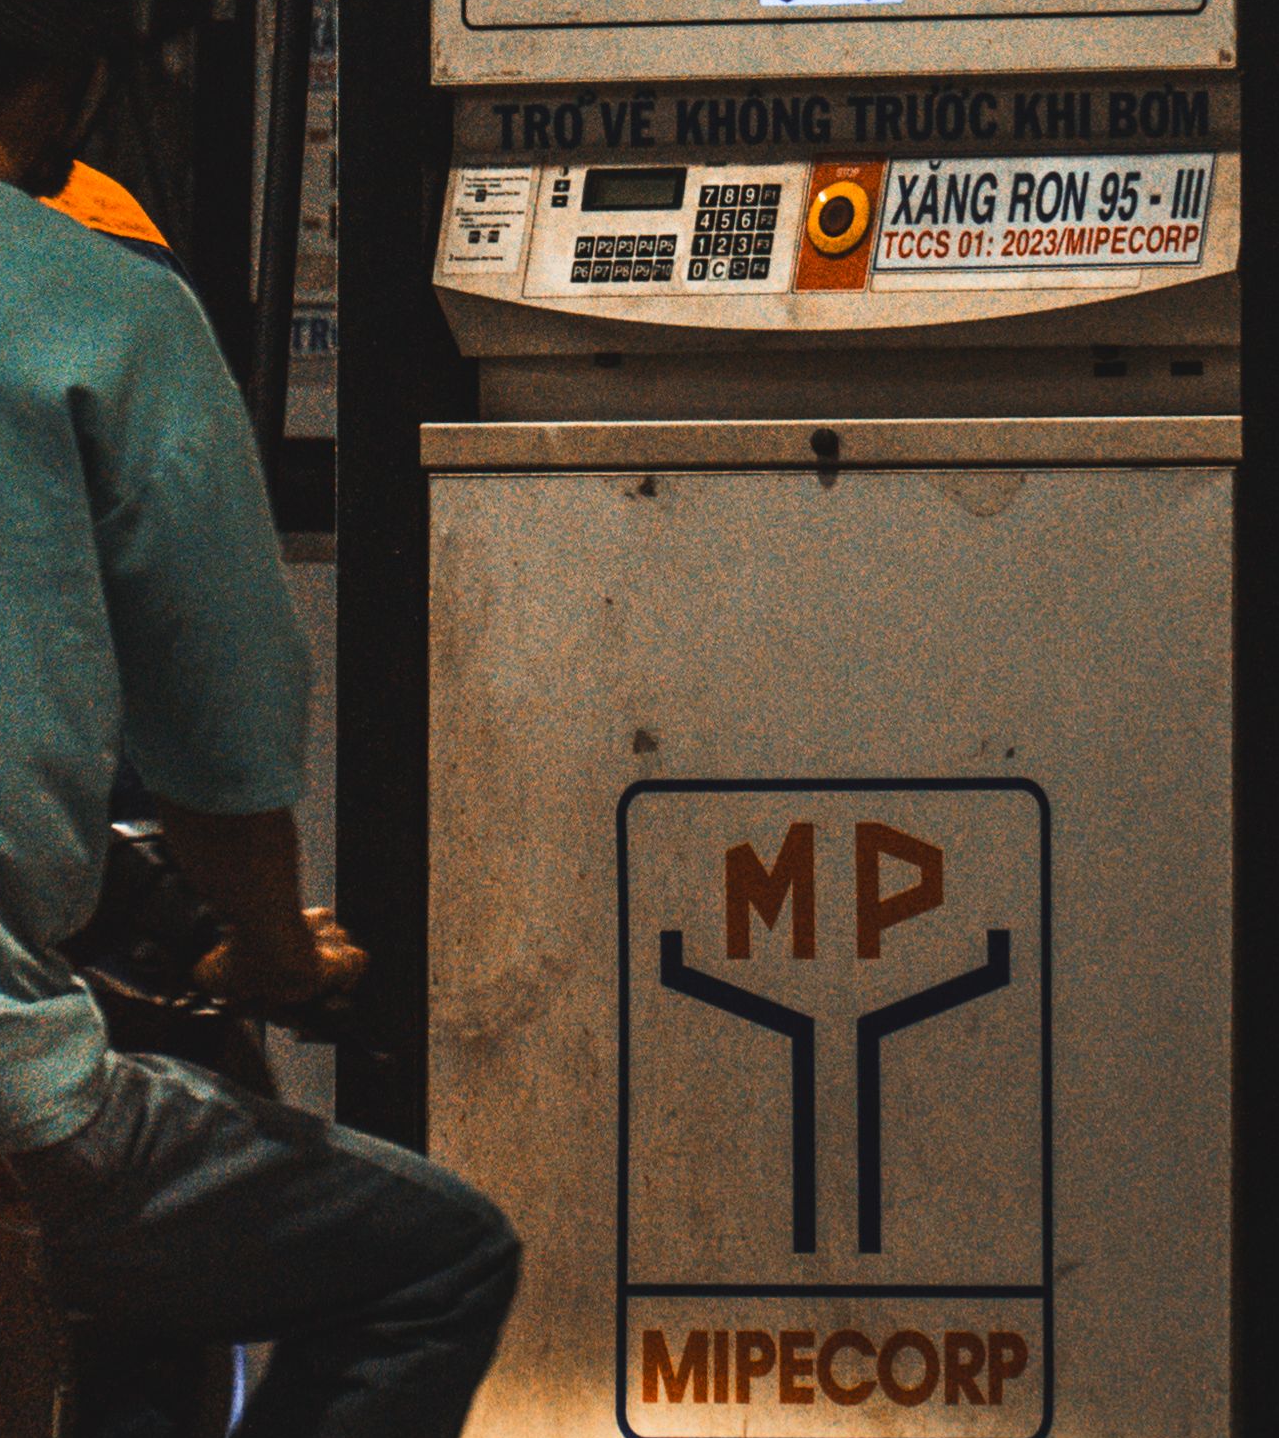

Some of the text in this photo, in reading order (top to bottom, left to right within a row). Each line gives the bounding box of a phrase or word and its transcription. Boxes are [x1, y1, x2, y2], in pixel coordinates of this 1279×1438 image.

[493, 89, 597, 151] TRỞ
[676, 87, 830, 147] KHÔNG
[1013, 92, 1092, 140] KHI
[1109, 84, 1210, 139] BƠM
[836, 166, 860, 178] STOP
[705, 188, 715, 204] 7
[724, 188, 735, 204] 8
[745, 187, 756, 203] 9
[891, 160, 1206, 225] XĂNG RON 95 - III
[699, 213, 710, 229] 4
[720, 213, 730, 229] 5
[741, 212, 751, 229] 6
[577, 239, 674, 254] P1 P2 P3 P4 P5
[716, 237, 728, 253] 2
[737, 237, 748, 253] 3
[883, 225, 1201, 259] TCCS 01: 2023/MIPECORP
[573, 264, 589, 278] P6
[594, 264, 609, 278] P7
[614, 264, 630, 278] P8
[634, 264, 650, 278] P9
[692, 261, 703, 278] 0
[712, 261, 725, 277] C
[642, 1329, 1028, 1407] MIPECORP
